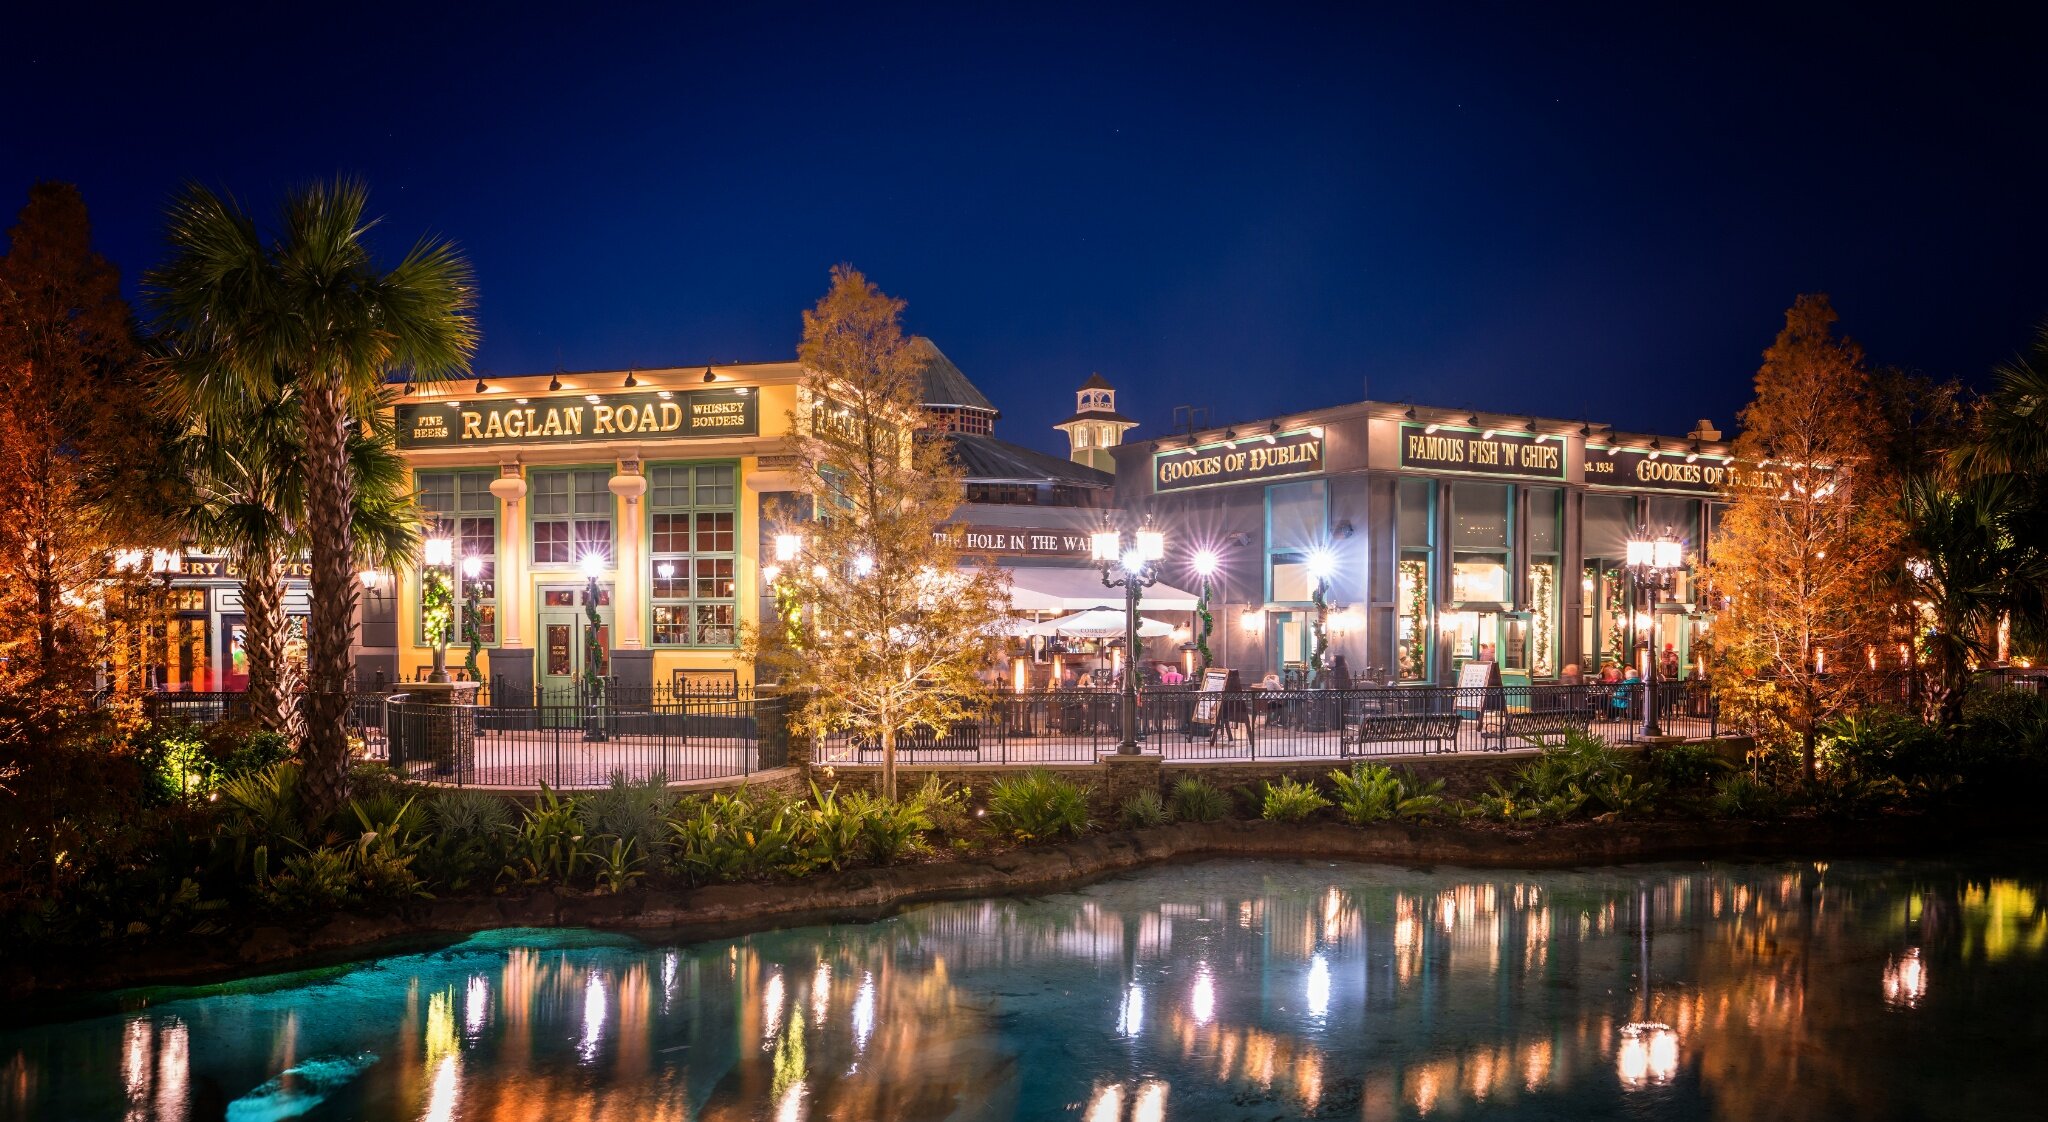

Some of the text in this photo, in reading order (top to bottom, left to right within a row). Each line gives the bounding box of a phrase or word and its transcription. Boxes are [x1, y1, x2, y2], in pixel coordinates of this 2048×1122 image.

[692, 402, 745, 415] WHISKEY
[418, 415, 443, 427] FINE
[461, 402, 683, 439] RAGLAN ROAD
[692, 415, 745, 428] BONDERS
[413, 427, 448, 438] BEERS
[1409, 435, 1558, 470] FAMOUS FISH 'N' CHIPS
[1159, 441, 1320, 484] COOKES OF DUBLIN
[1584, 461, 1614, 474] st. 1934
[1636, 459, 1701, 484] COOKES
[1703, 466, 1724, 484] OF
[967, 533, 1006, 549] HOLE
[1010, 535, 1026, 550] IN
[1030, 535, 1058, 550] THE
[1063, 536, 1093, 551] WAL
